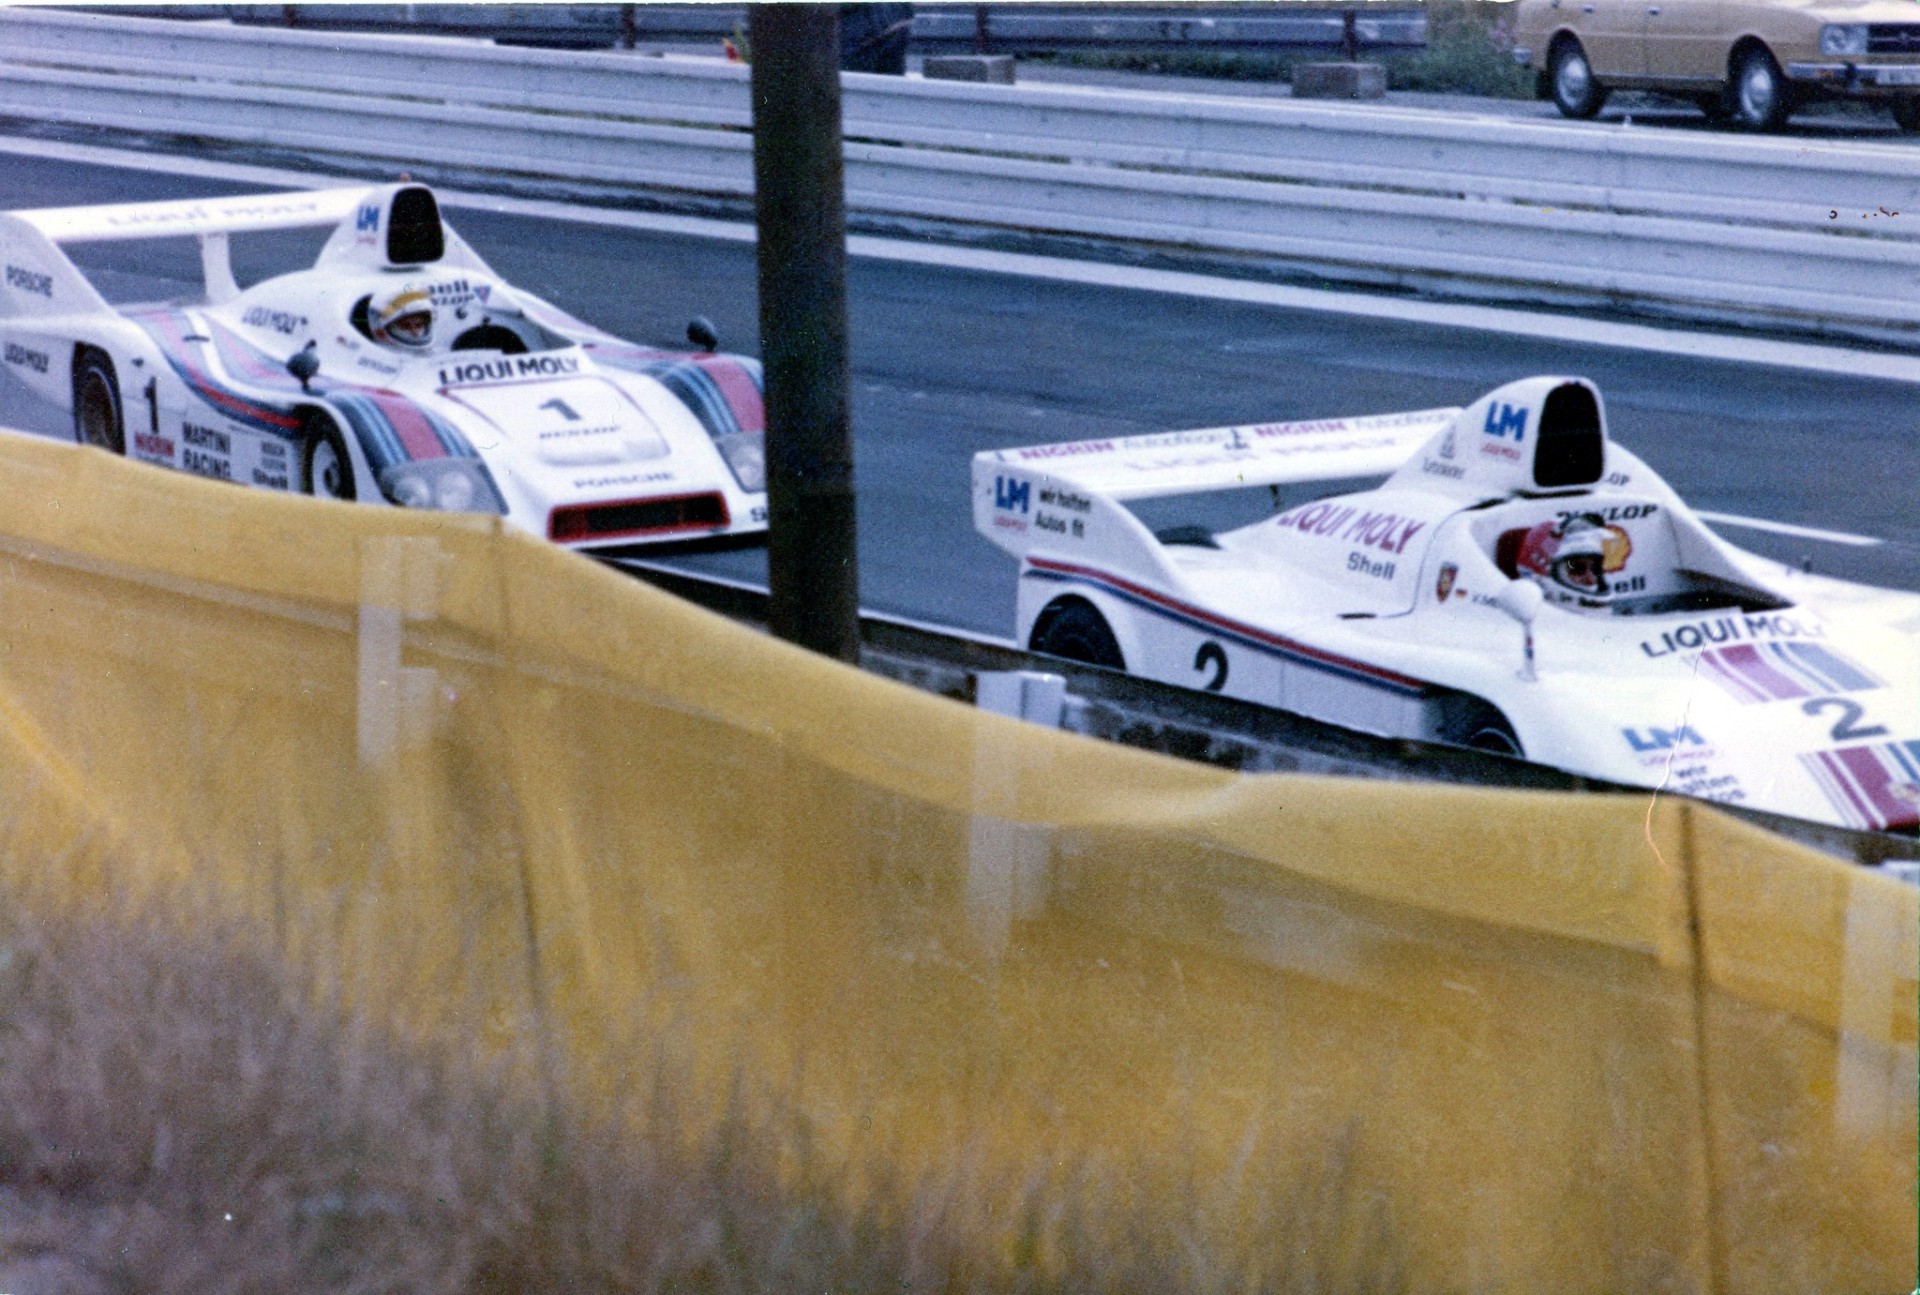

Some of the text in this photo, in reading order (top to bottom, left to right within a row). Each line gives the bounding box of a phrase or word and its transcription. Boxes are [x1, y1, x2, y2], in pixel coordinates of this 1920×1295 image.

[357, 205, 380, 232] LM
[7, 264, 53, 298] PORSCHE
[439, 355, 579, 386] LIQUI MOLY
[143, 374, 159, 434] 1
[538, 397, 584, 423] 1
[1484, 400, 1530, 443] LM
[182, 420, 232, 456] MARTINI
[1018, 440, 1116, 460] NIGRIN
[1253, 420, 1350, 439] NIGRIN
[182, 446, 232, 480] RACING
[995, 475, 1031, 515] LM
[1034, 509, 1067, 535] Autos
[1342, 510, 1426, 554] MOLY
[1557, 505, 1658, 529] DLOP
[1346, 551, 1397, 581] Shell
[1640, 616, 1742, 659] LIQUI
[1195, 641, 1230, 691] 2
[1800, 696, 1893, 742] 2
[1621, 724, 1708, 753] LM
